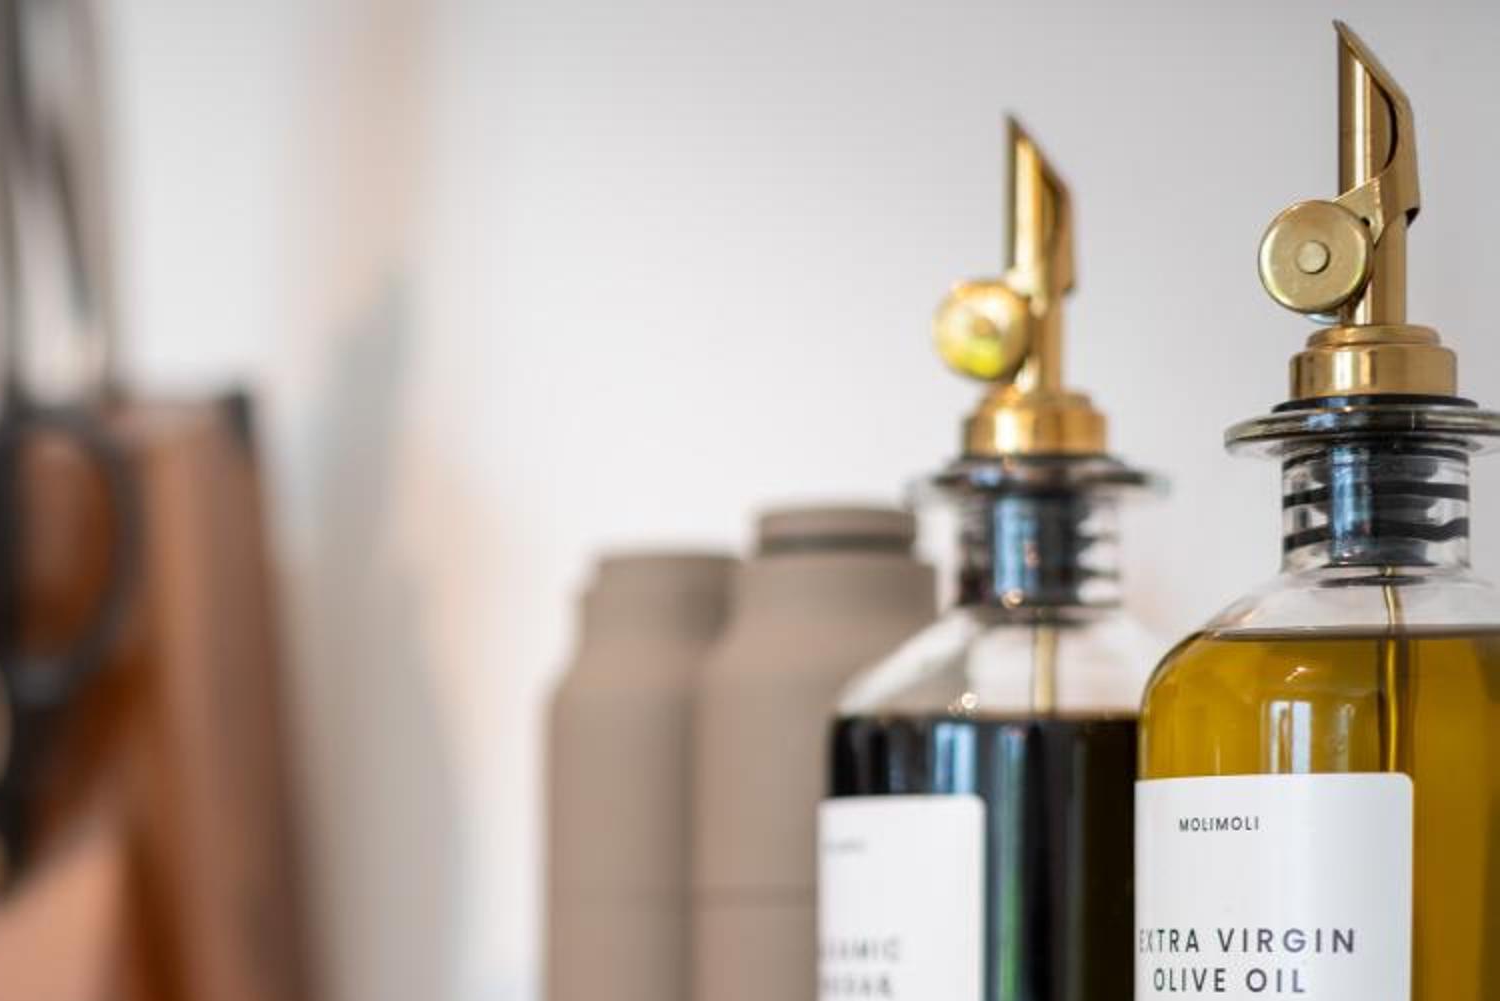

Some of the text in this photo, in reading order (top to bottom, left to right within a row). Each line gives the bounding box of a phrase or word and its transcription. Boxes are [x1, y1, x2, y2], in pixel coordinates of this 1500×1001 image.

[1178, 815, 1260, 832] MOLIMOLI
[1217, 927, 1355, 954] VIRGIN
[1153, 967, 1306, 993] OLIVE OIL
